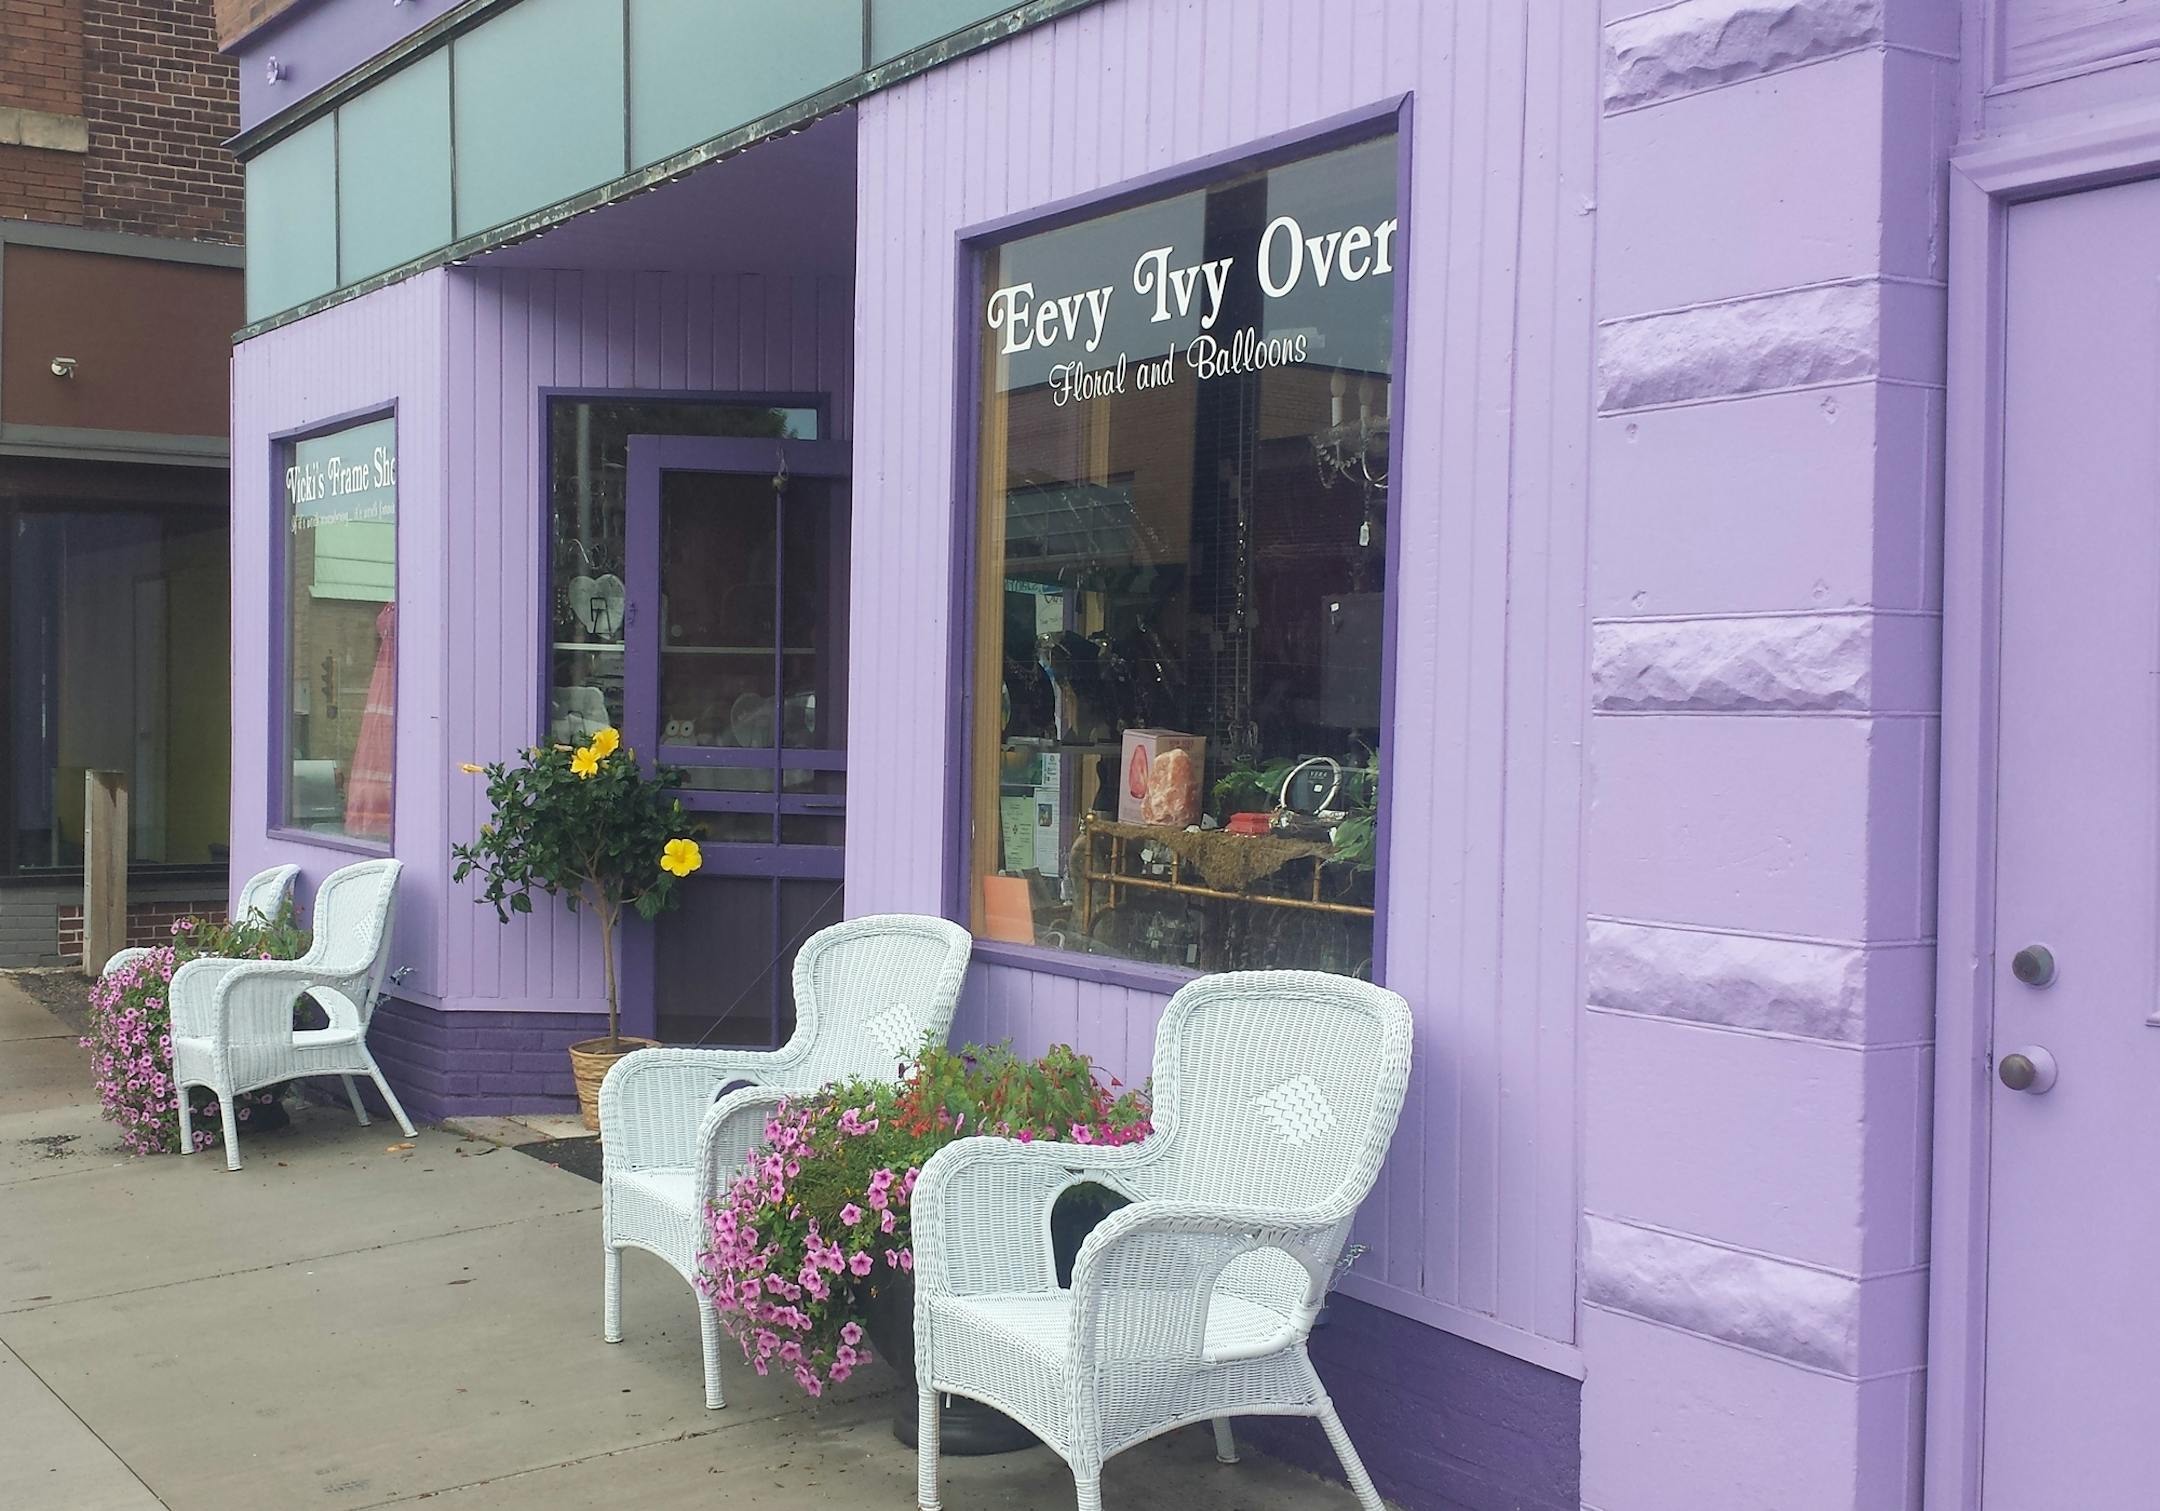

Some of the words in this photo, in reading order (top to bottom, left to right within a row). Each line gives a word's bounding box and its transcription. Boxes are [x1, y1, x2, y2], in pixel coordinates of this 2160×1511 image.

[986, 282, 1114, 355] Eevy
[1133, 246, 1234, 329] Ivy
[1257, 215, 1398, 299] Over
[1048, 352, 1126, 407] Floral
[1136, 343, 1175, 389] and
[1187, 326, 1308, 380] Balloons
[286, 461, 325, 504] Vicki's
[327, 456, 369, 496] Frame
